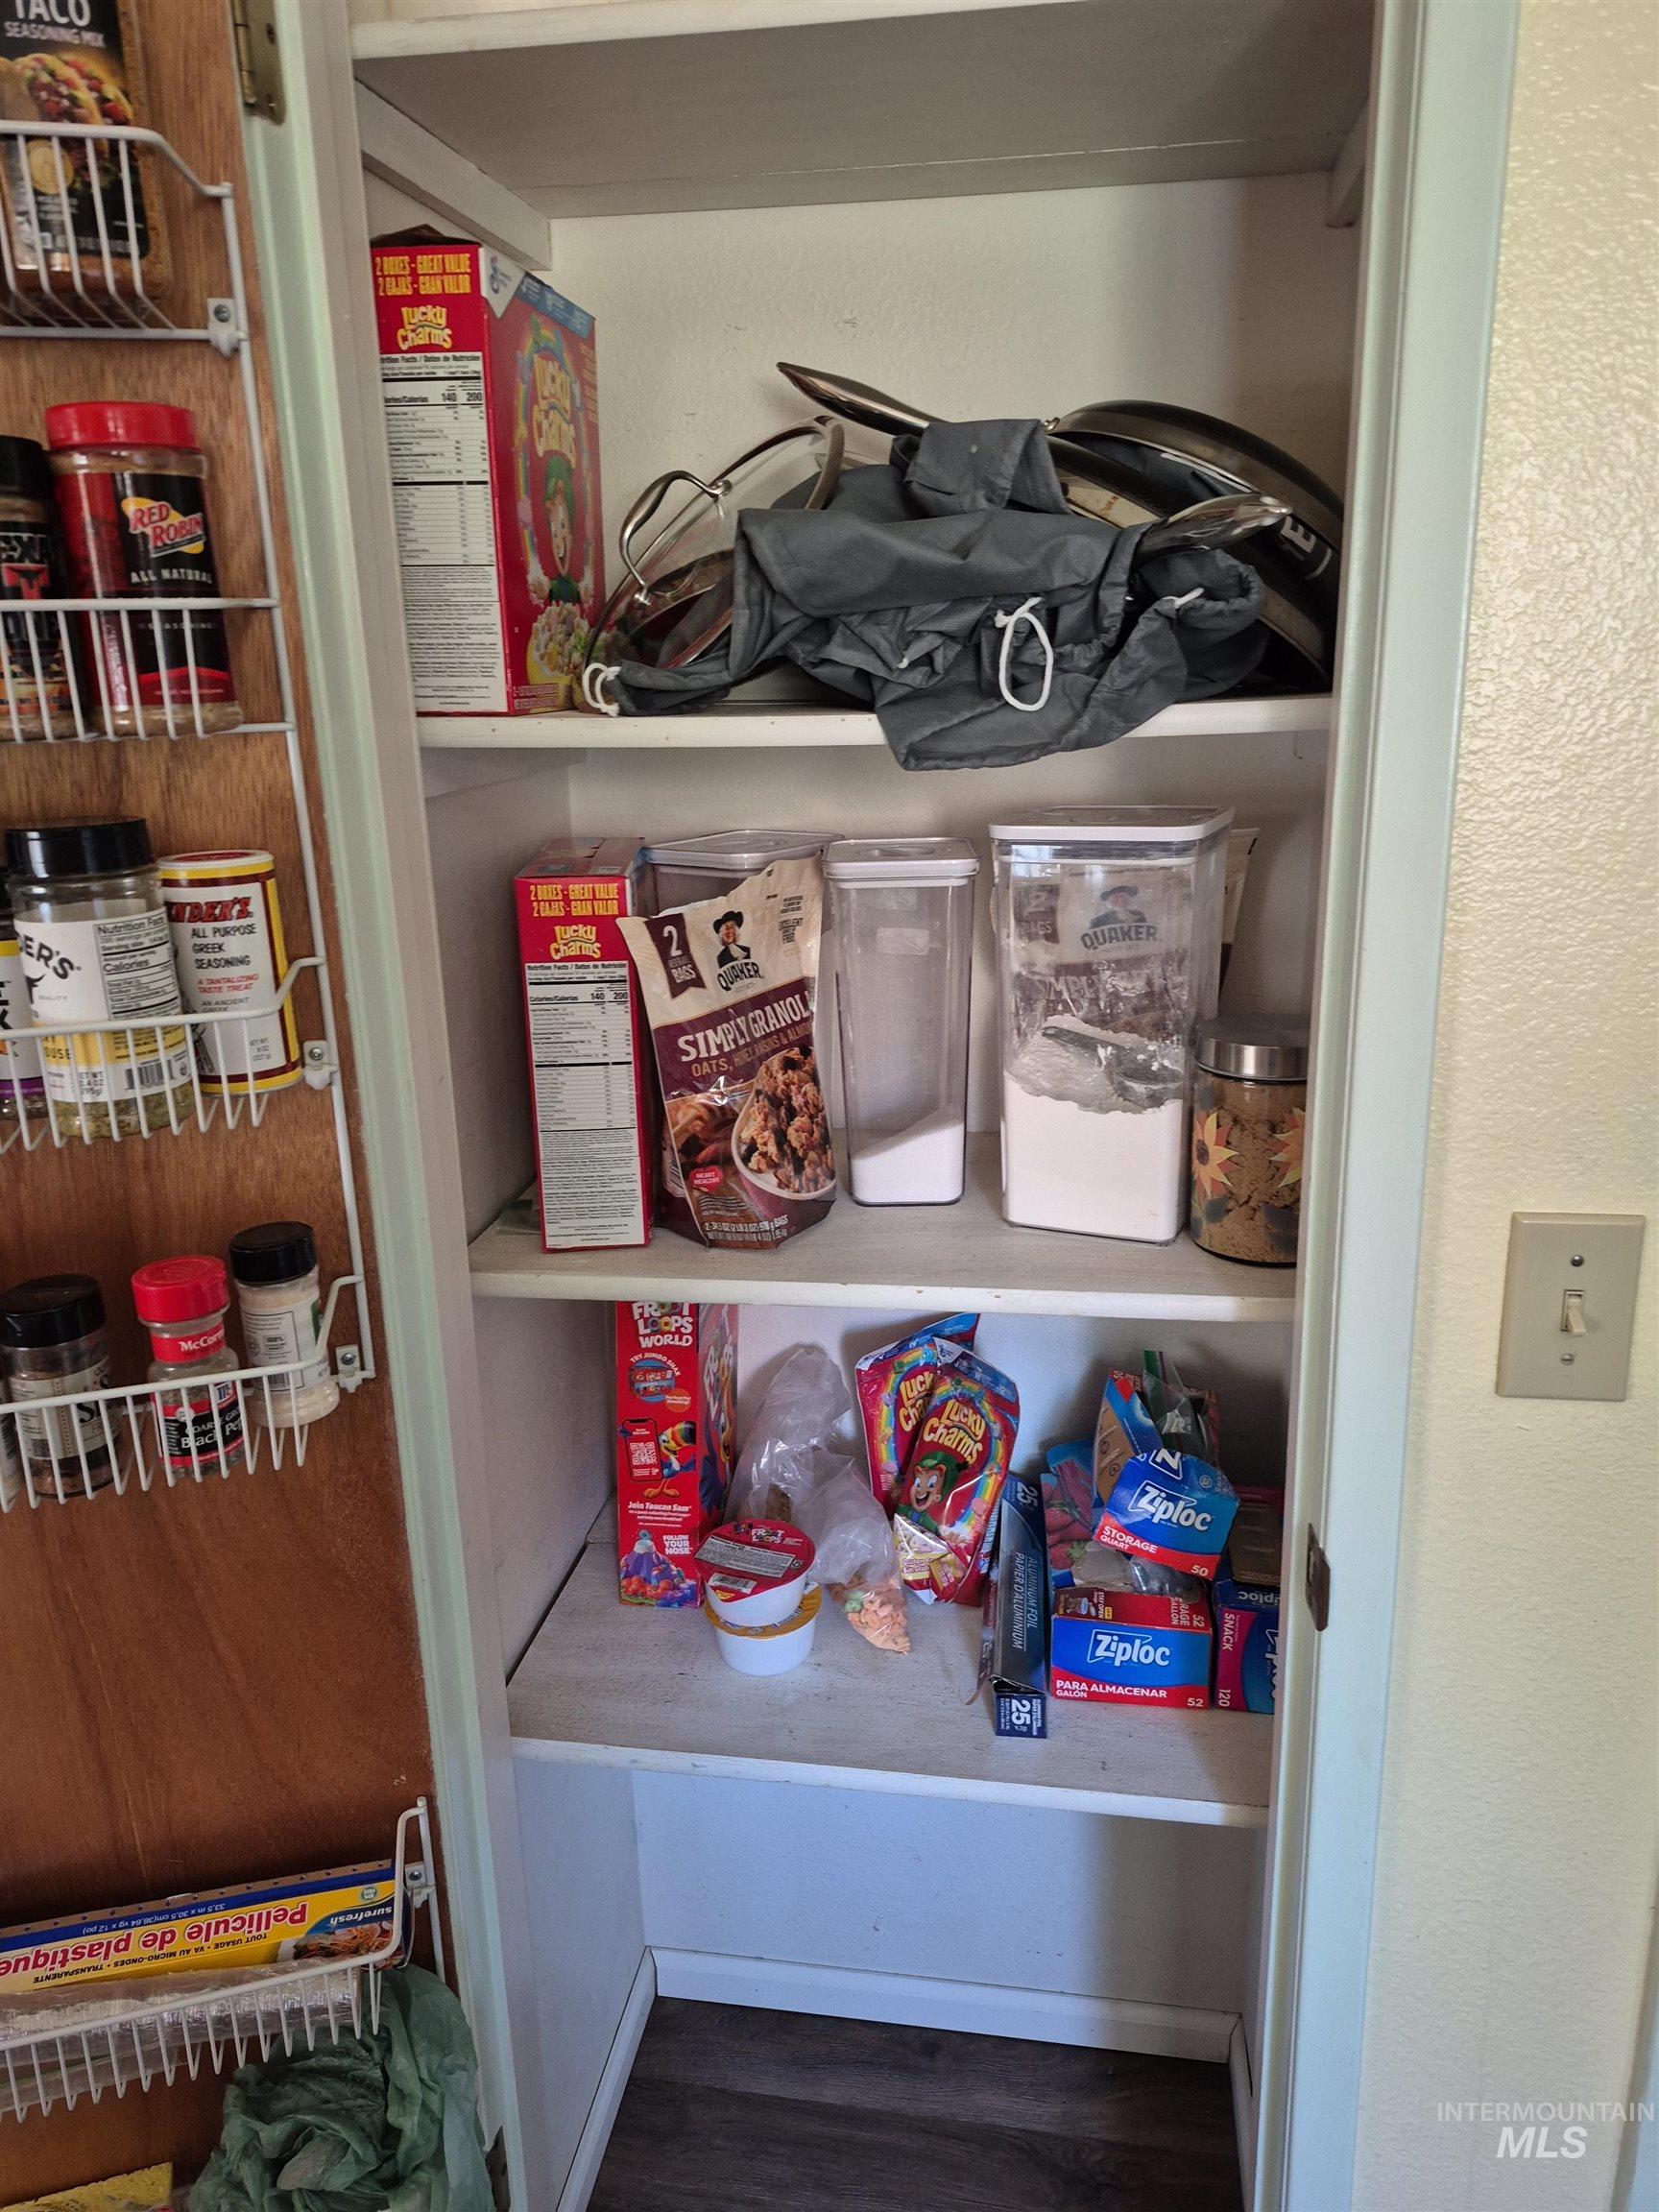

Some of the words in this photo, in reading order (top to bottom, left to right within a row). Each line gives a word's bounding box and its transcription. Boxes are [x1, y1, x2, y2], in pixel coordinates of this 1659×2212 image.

[417, 254, 444, 275] GREAT
[444, 253, 470, 274] VALUE
[397, 326, 453, 350] Charms
[442, 393, 457, 402] 140
[130, 504, 170, 532] RED
[151, 517, 203, 551] ROBIN
[132, 569, 156, 584] ALL
[530, 885, 537, 901] 2
[537, 884, 563, 901] BOXES
[568, 884, 593, 900] GREAT
[593, 883, 619, 900] VALUE
[533, 902, 539, 917] 2
[540, 901, 565, 917] CAJAS
[571, 901, 593, 916] GRAN
[593, 900, 619, 915] VALOR
[98, 921, 145, 935] Nutrition
[192, 927, 208, 939] ALL
[212, 924, 257, 938] PURPOSE
[663, 925, 683, 957] 2
[1080, 925, 1158, 951] QUAKER
[193, 942, 226, 954] GREEK
[549, 941, 602, 960] Charms
[103, 959, 150, 974] Calories
[195, 955, 252, 970] SEASONING
[670, 964, 697, 984] BAGS
[716, 961, 760, 992] QUAKER
[198, 985, 224, 995] TASTE
[227, 983, 254, 994] TREAT
[590, 992, 605, 1000] 140
[613, 991, 629, 1000] 200
[677, 1016, 751, 1063] SIMPLY
[691, 1058, 734, 1077] OATS,
[637, 1315, 693, 1334] LOOPS
[638, 1334, 693, 1349] WORLD
[630, 1353, 643, 1363] TRY
[643, 1352, 668, 1362] JUMBO
[923, 1417, 984, 1465] Charms
[1016, 1480, 1039, 1507] 25
[628, 1501, 644, 1510] Join
[645, 1502, 672, 1511] Toucan
[672, 1503, 690, 1512] Sam
[1136, 1485, 1213, 1532] Ziploc
[1099, 1534, 1131, 1551] QUART
[1102, 1526, 1159, 1553] STORAGE
[665, 1547, 691, 1555] NOSE
[1014, 1551, 1025, 1584] PAPIER
[1190, 1564, 1210, 1577] 50
[1026, 1607, 1039, 1629] FOIL
[1192, 1613, 1206, 1628] 52
[1221, 1612, 1236, 1651] SNACK
[1094, 1633, 1171, 1668] Ziploc
[1056, 1679, 1089, 1692] PARA
[1090, 1683, 1167, 1699] ALMACENAR
[1217, 1688, 1232, 1708] 120
[1011, 1698, 1031, 1725] 25
[1187, 1697, 1204, 1708] 52
[185, 1902, 308, 1944] Pellicule
[330, 1905, 393, 1926] surefresh
[99, 1924, 109, 1933] 12
[141, 1928, 177, 1952] de
[213, 1937, 243, 1950] USAGE
[245, 1932, 268, 1945] TOUT
[0, 1931, 133, 1978] plastique
[179, 1948, 191, 1957] AU
[191, 1945, 204, 1954] VA
[113, 1950, 178, 1969] MICRO-ONDES
[33, 1962, 105, 1984] TRANSPARENTE
